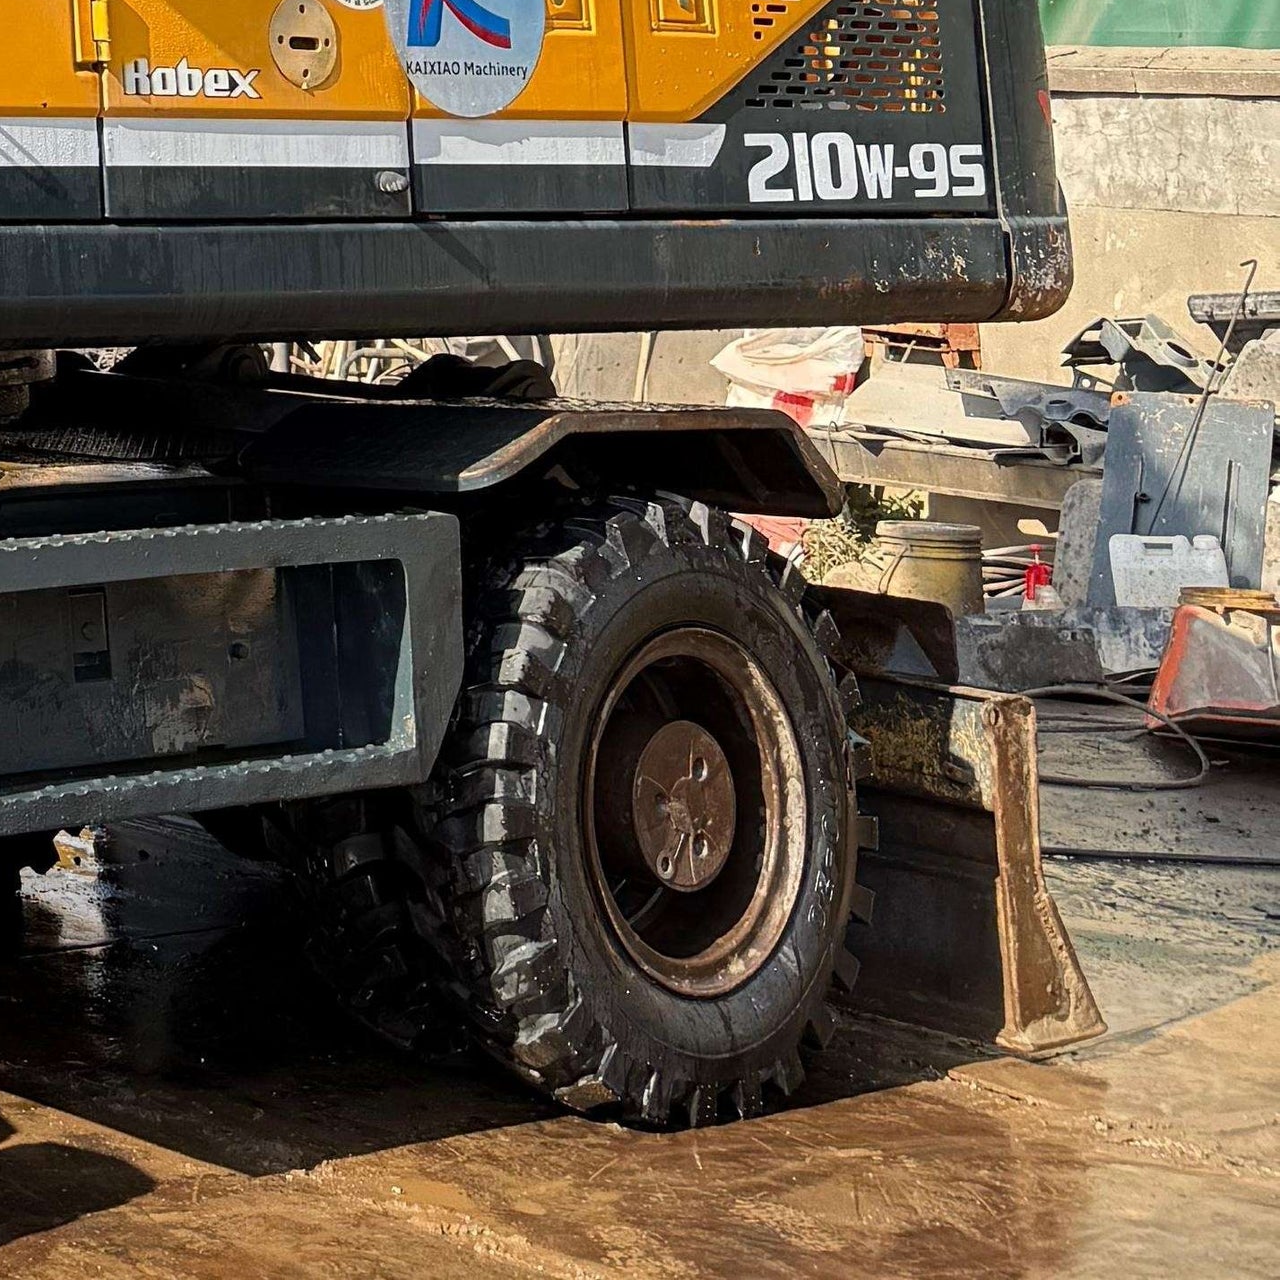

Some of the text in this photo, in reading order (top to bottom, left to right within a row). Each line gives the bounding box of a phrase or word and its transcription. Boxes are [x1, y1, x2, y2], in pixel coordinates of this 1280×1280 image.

[123, 56, 263, 99] Robex
[406, 60, 528, 80] KAIXIAO Machinery
